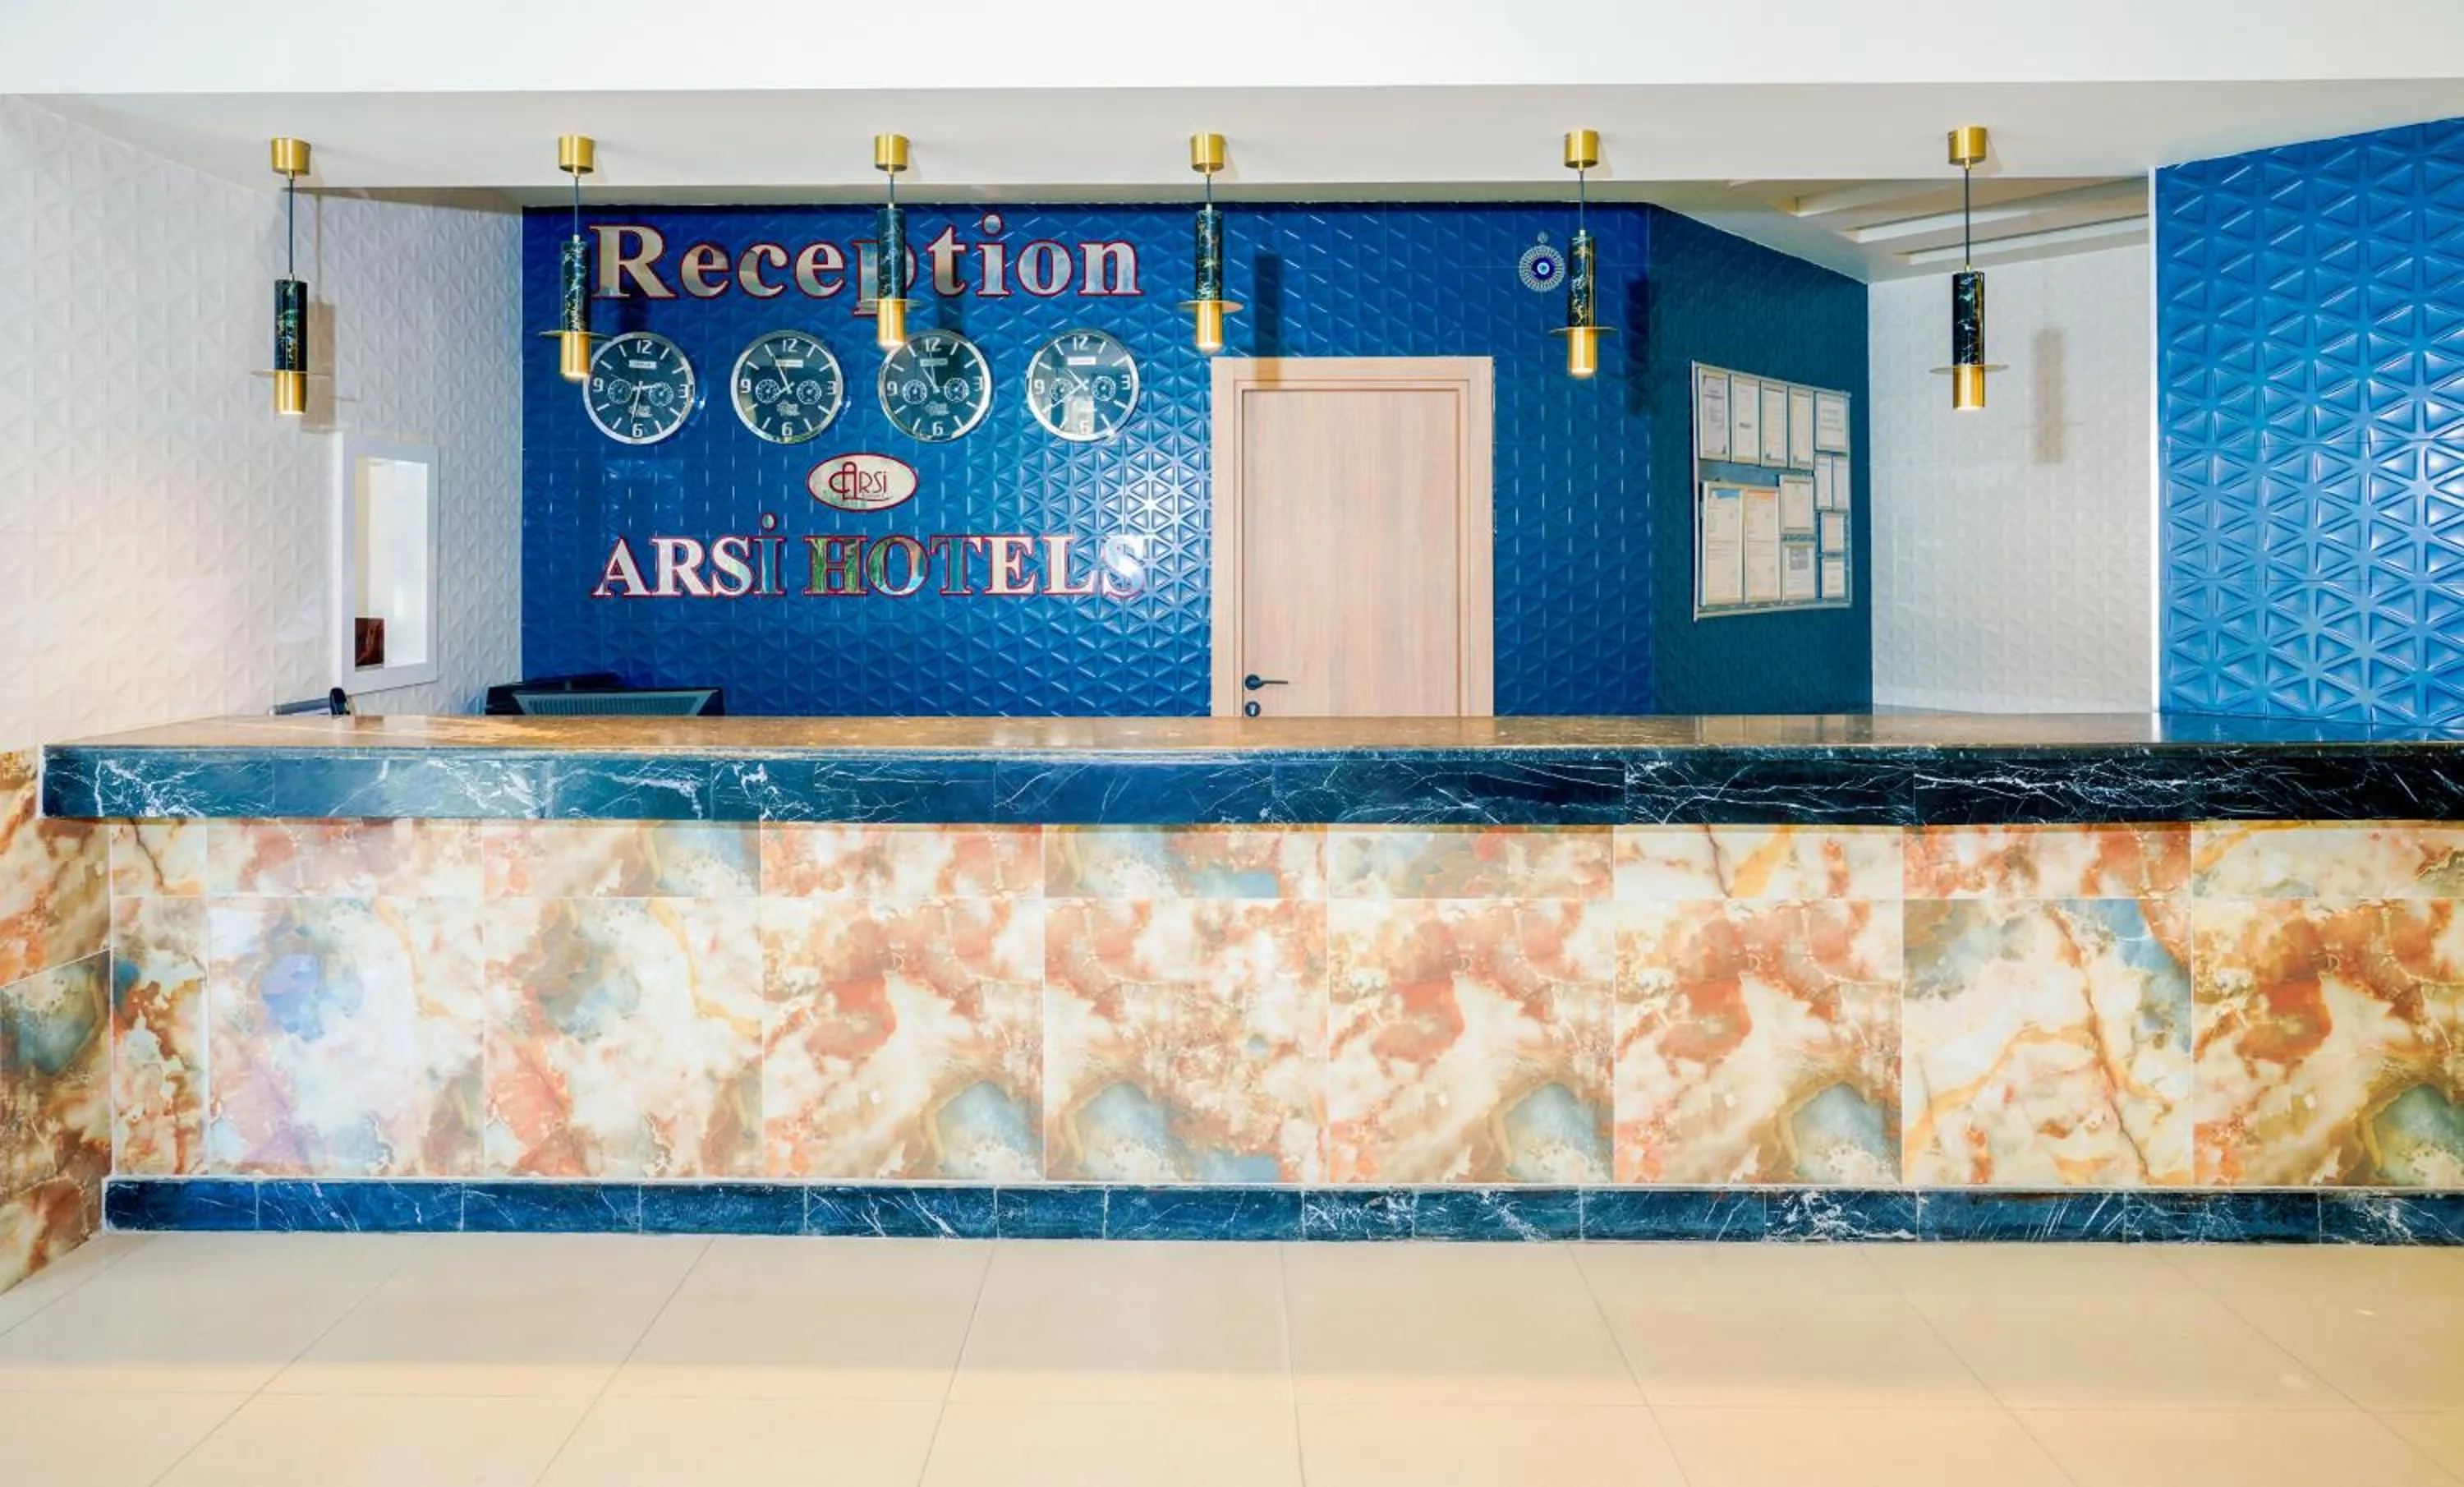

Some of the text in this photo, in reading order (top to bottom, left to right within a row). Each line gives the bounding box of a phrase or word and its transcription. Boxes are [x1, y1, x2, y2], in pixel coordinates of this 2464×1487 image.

[637, 339, 653, 354] 12
[782, 338, 798, 352] 12
[925, 337, 941, 352] 12
[1073, 335, 1089, 351] 12
[593, 377, 604, 393] 9
[740, 379, 752, 394] 9
[827, 380, 838, 395] 3
[887, 380, 898, 396] 9
[972, 375, 983, 392] 3
[1035, 379, 1046, 394] 9
[1121, 374, 1131, 390] 3
[678, 384, 688, 398] 3
[632, 423, 643, 438] 6
[781, 421, 793, 436] 6
[932, 421, 944, 436] 6
[802, 534, 1147, 599] HOTELS
